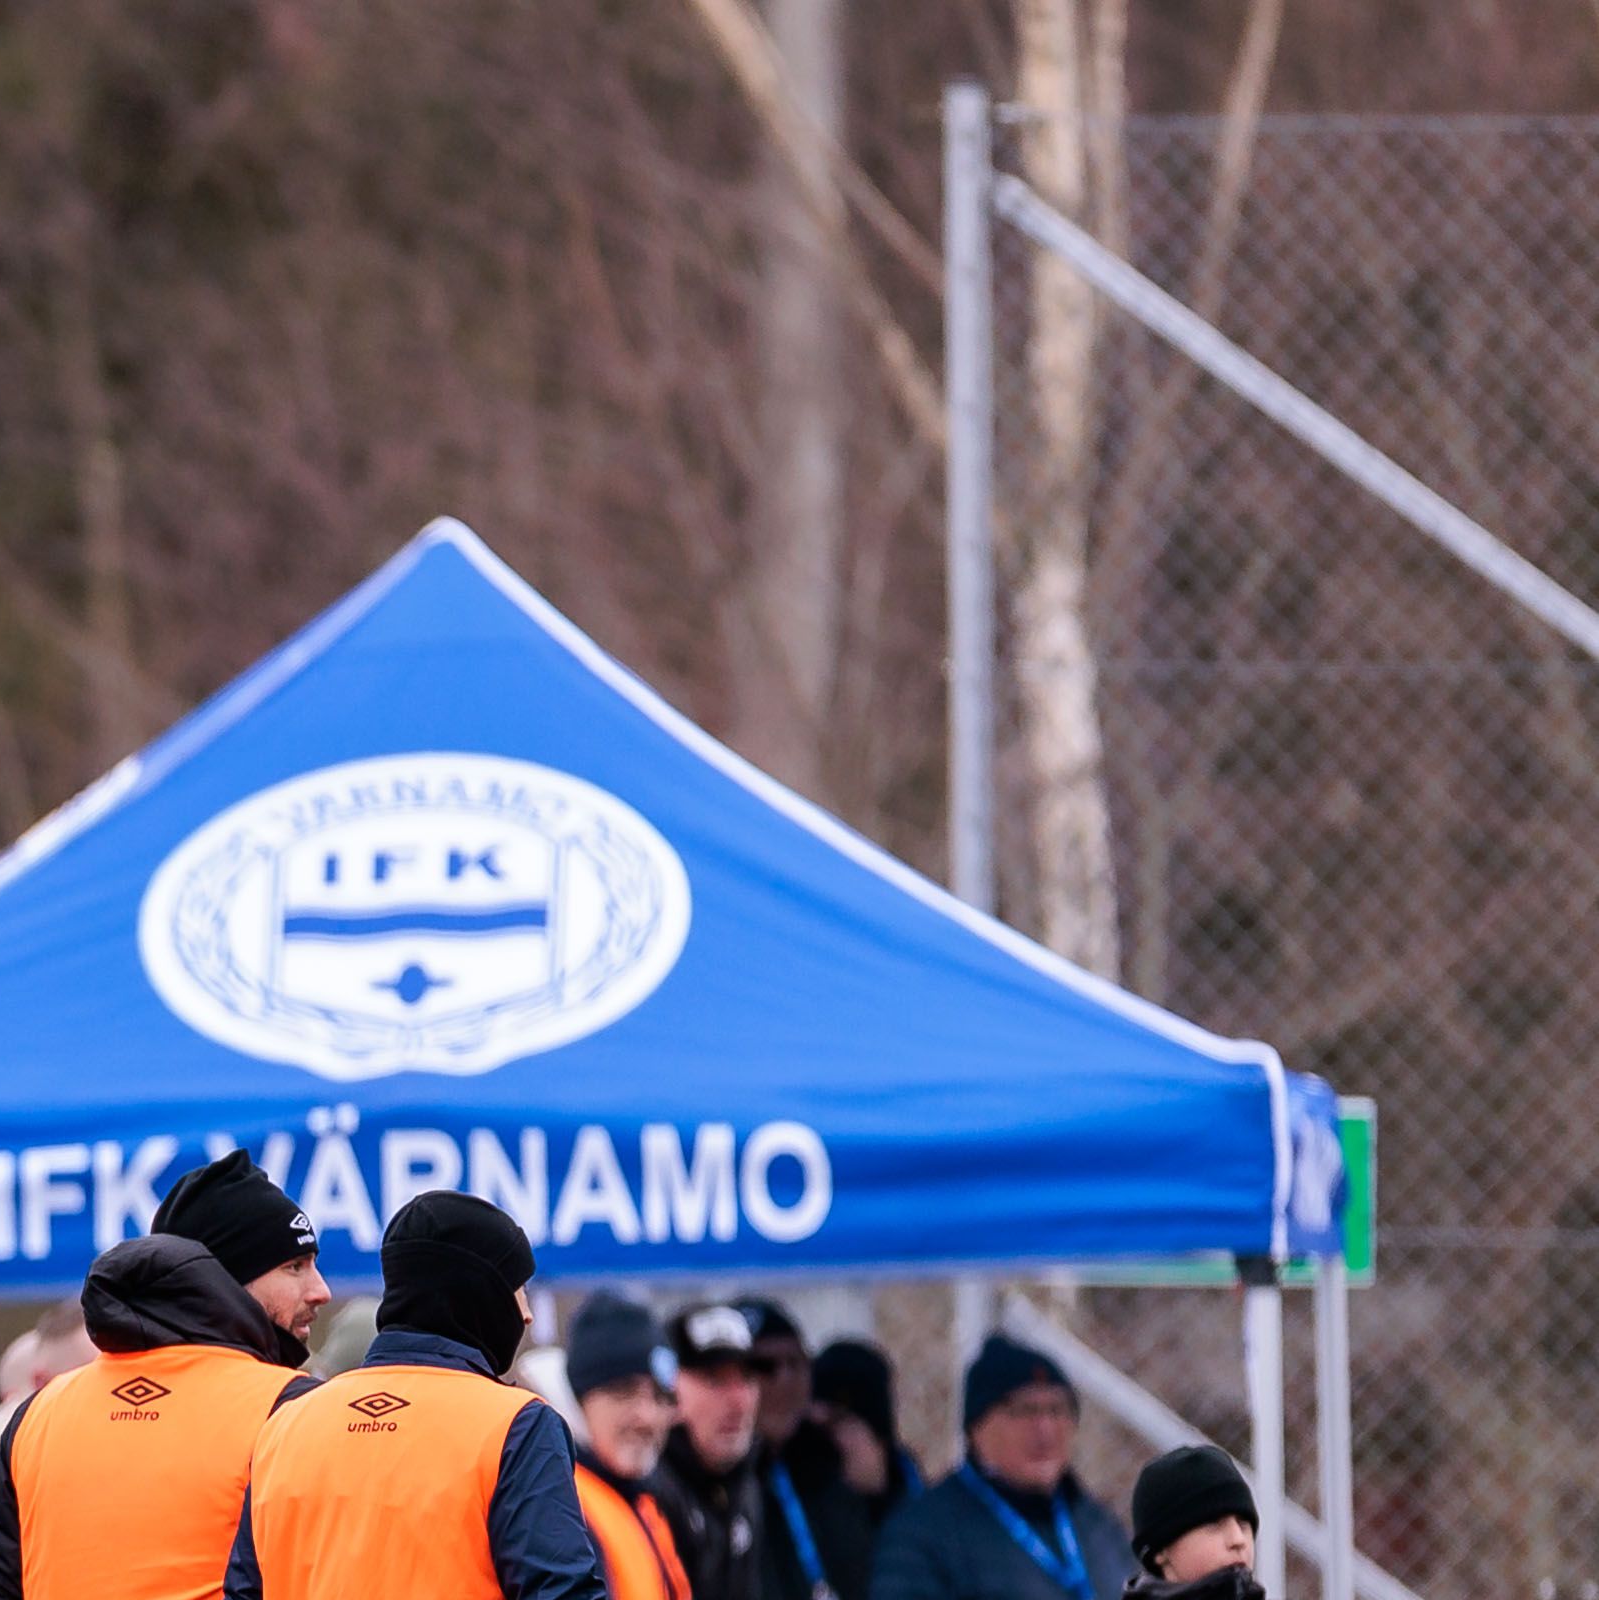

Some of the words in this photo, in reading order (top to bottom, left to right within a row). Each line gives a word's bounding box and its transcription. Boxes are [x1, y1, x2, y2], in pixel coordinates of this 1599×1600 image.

[322, 842, 510, 885] IFK
[109, 1408, 160, 1422] umbro
[347, 1419, 398, 1434] umbro
